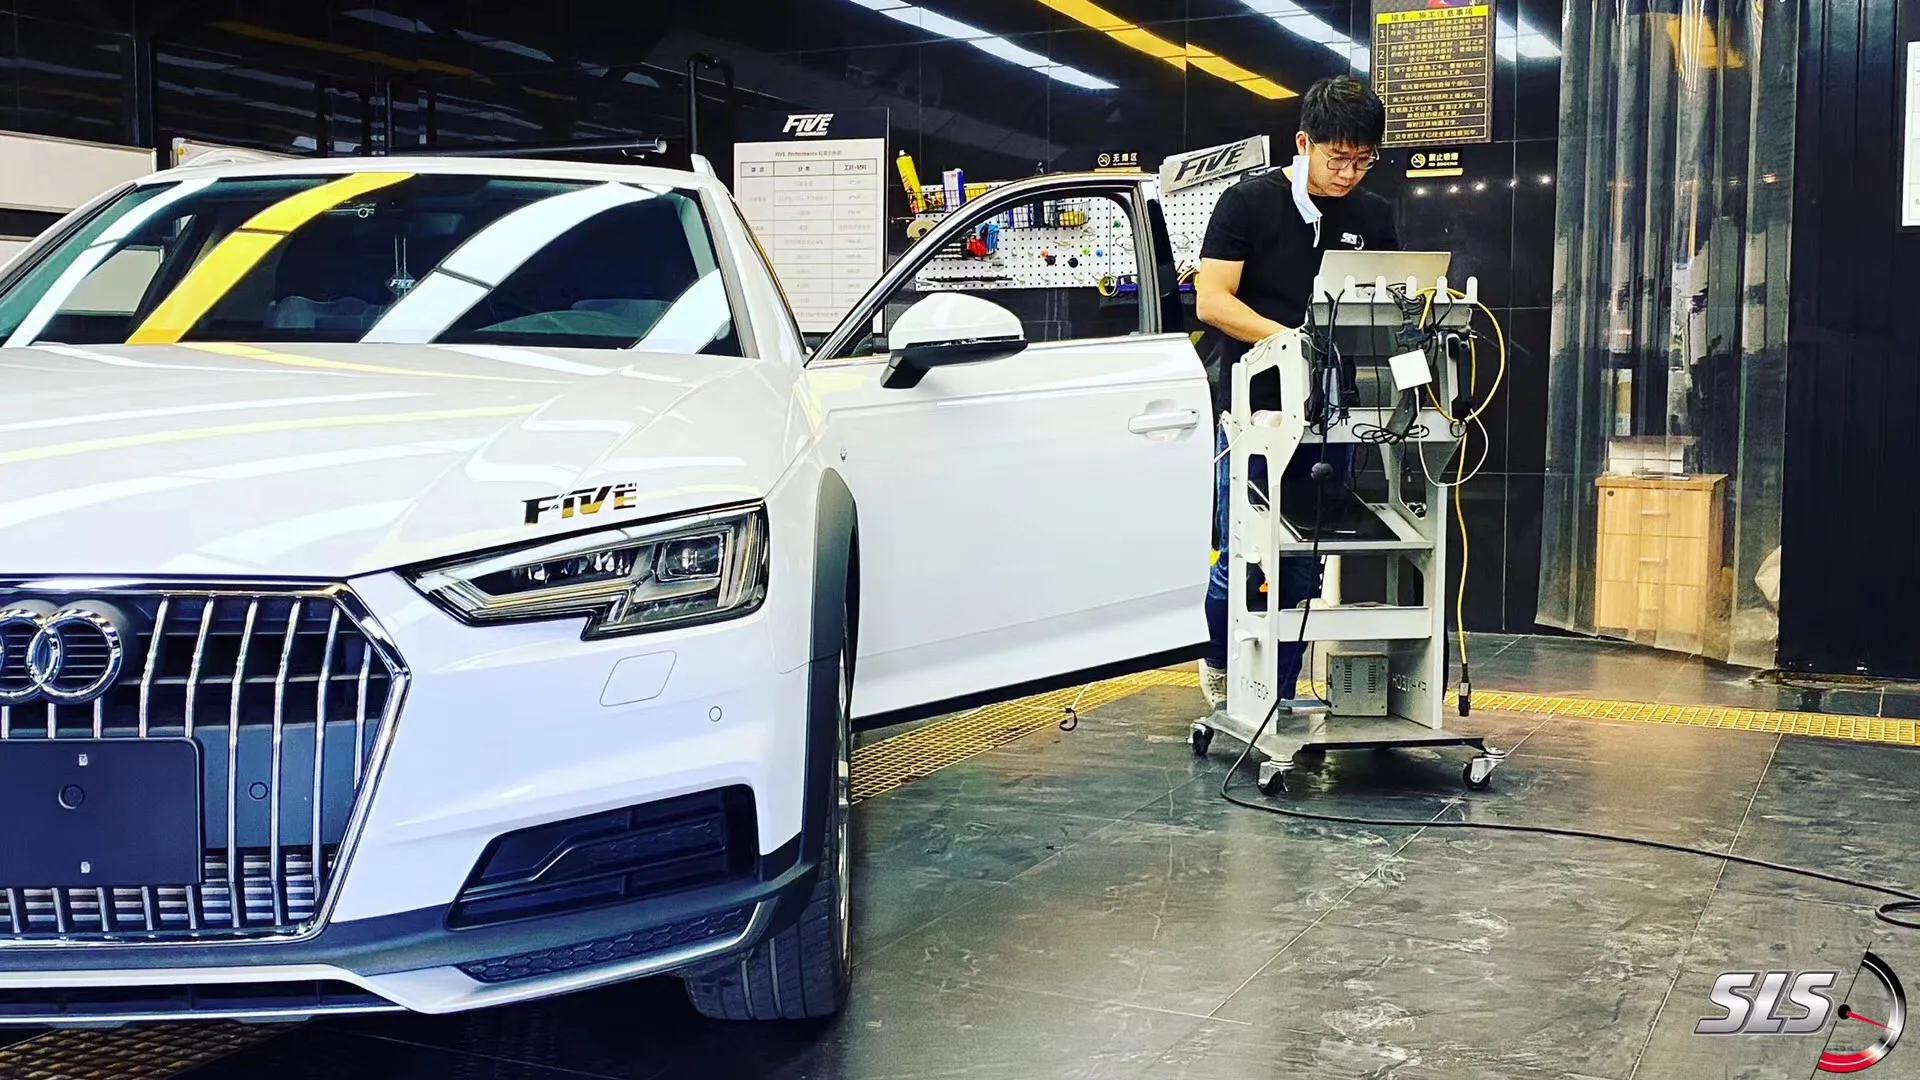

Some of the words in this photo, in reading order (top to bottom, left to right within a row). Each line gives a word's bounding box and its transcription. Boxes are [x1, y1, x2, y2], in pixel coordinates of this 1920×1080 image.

[1380, 29, 1385, 39] 1
[1378, 51, 1385, 60] 2
[1378, 70, 1385, 79] 3
[1378, 84, 1385, 93] 4
[782, 113, 834, 133] FIVE
[1112, 152, 1138, 163] 无烟区
[1174, 141, 1248, 182] FIVE
[521, 482, 637, 525] FIVE
